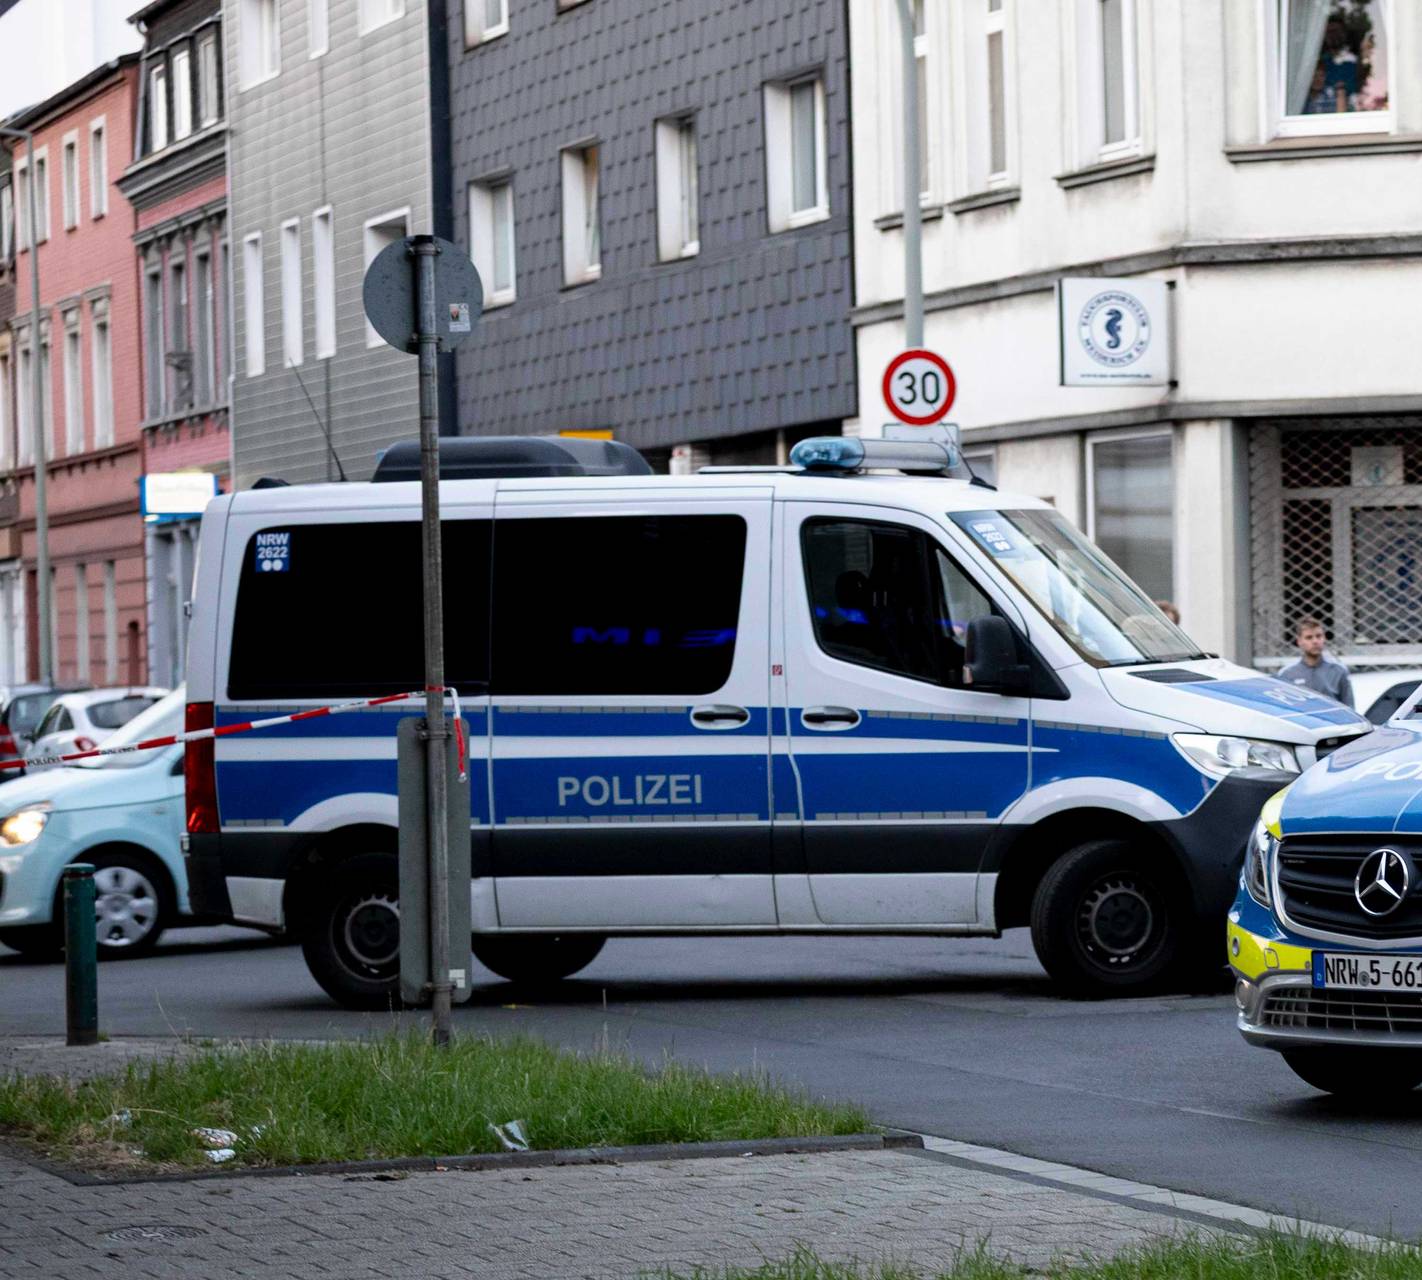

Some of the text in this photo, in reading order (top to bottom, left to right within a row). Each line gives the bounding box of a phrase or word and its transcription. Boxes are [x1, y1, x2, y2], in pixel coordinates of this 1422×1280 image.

[897, 370, 940, 405] 30
[257, 533, 290, 546] NRW
[258, 546, 289, 559] 2622
[557, 774, 703, 807] POLIZEI
[1325, 958, 1358, 986] NRW
